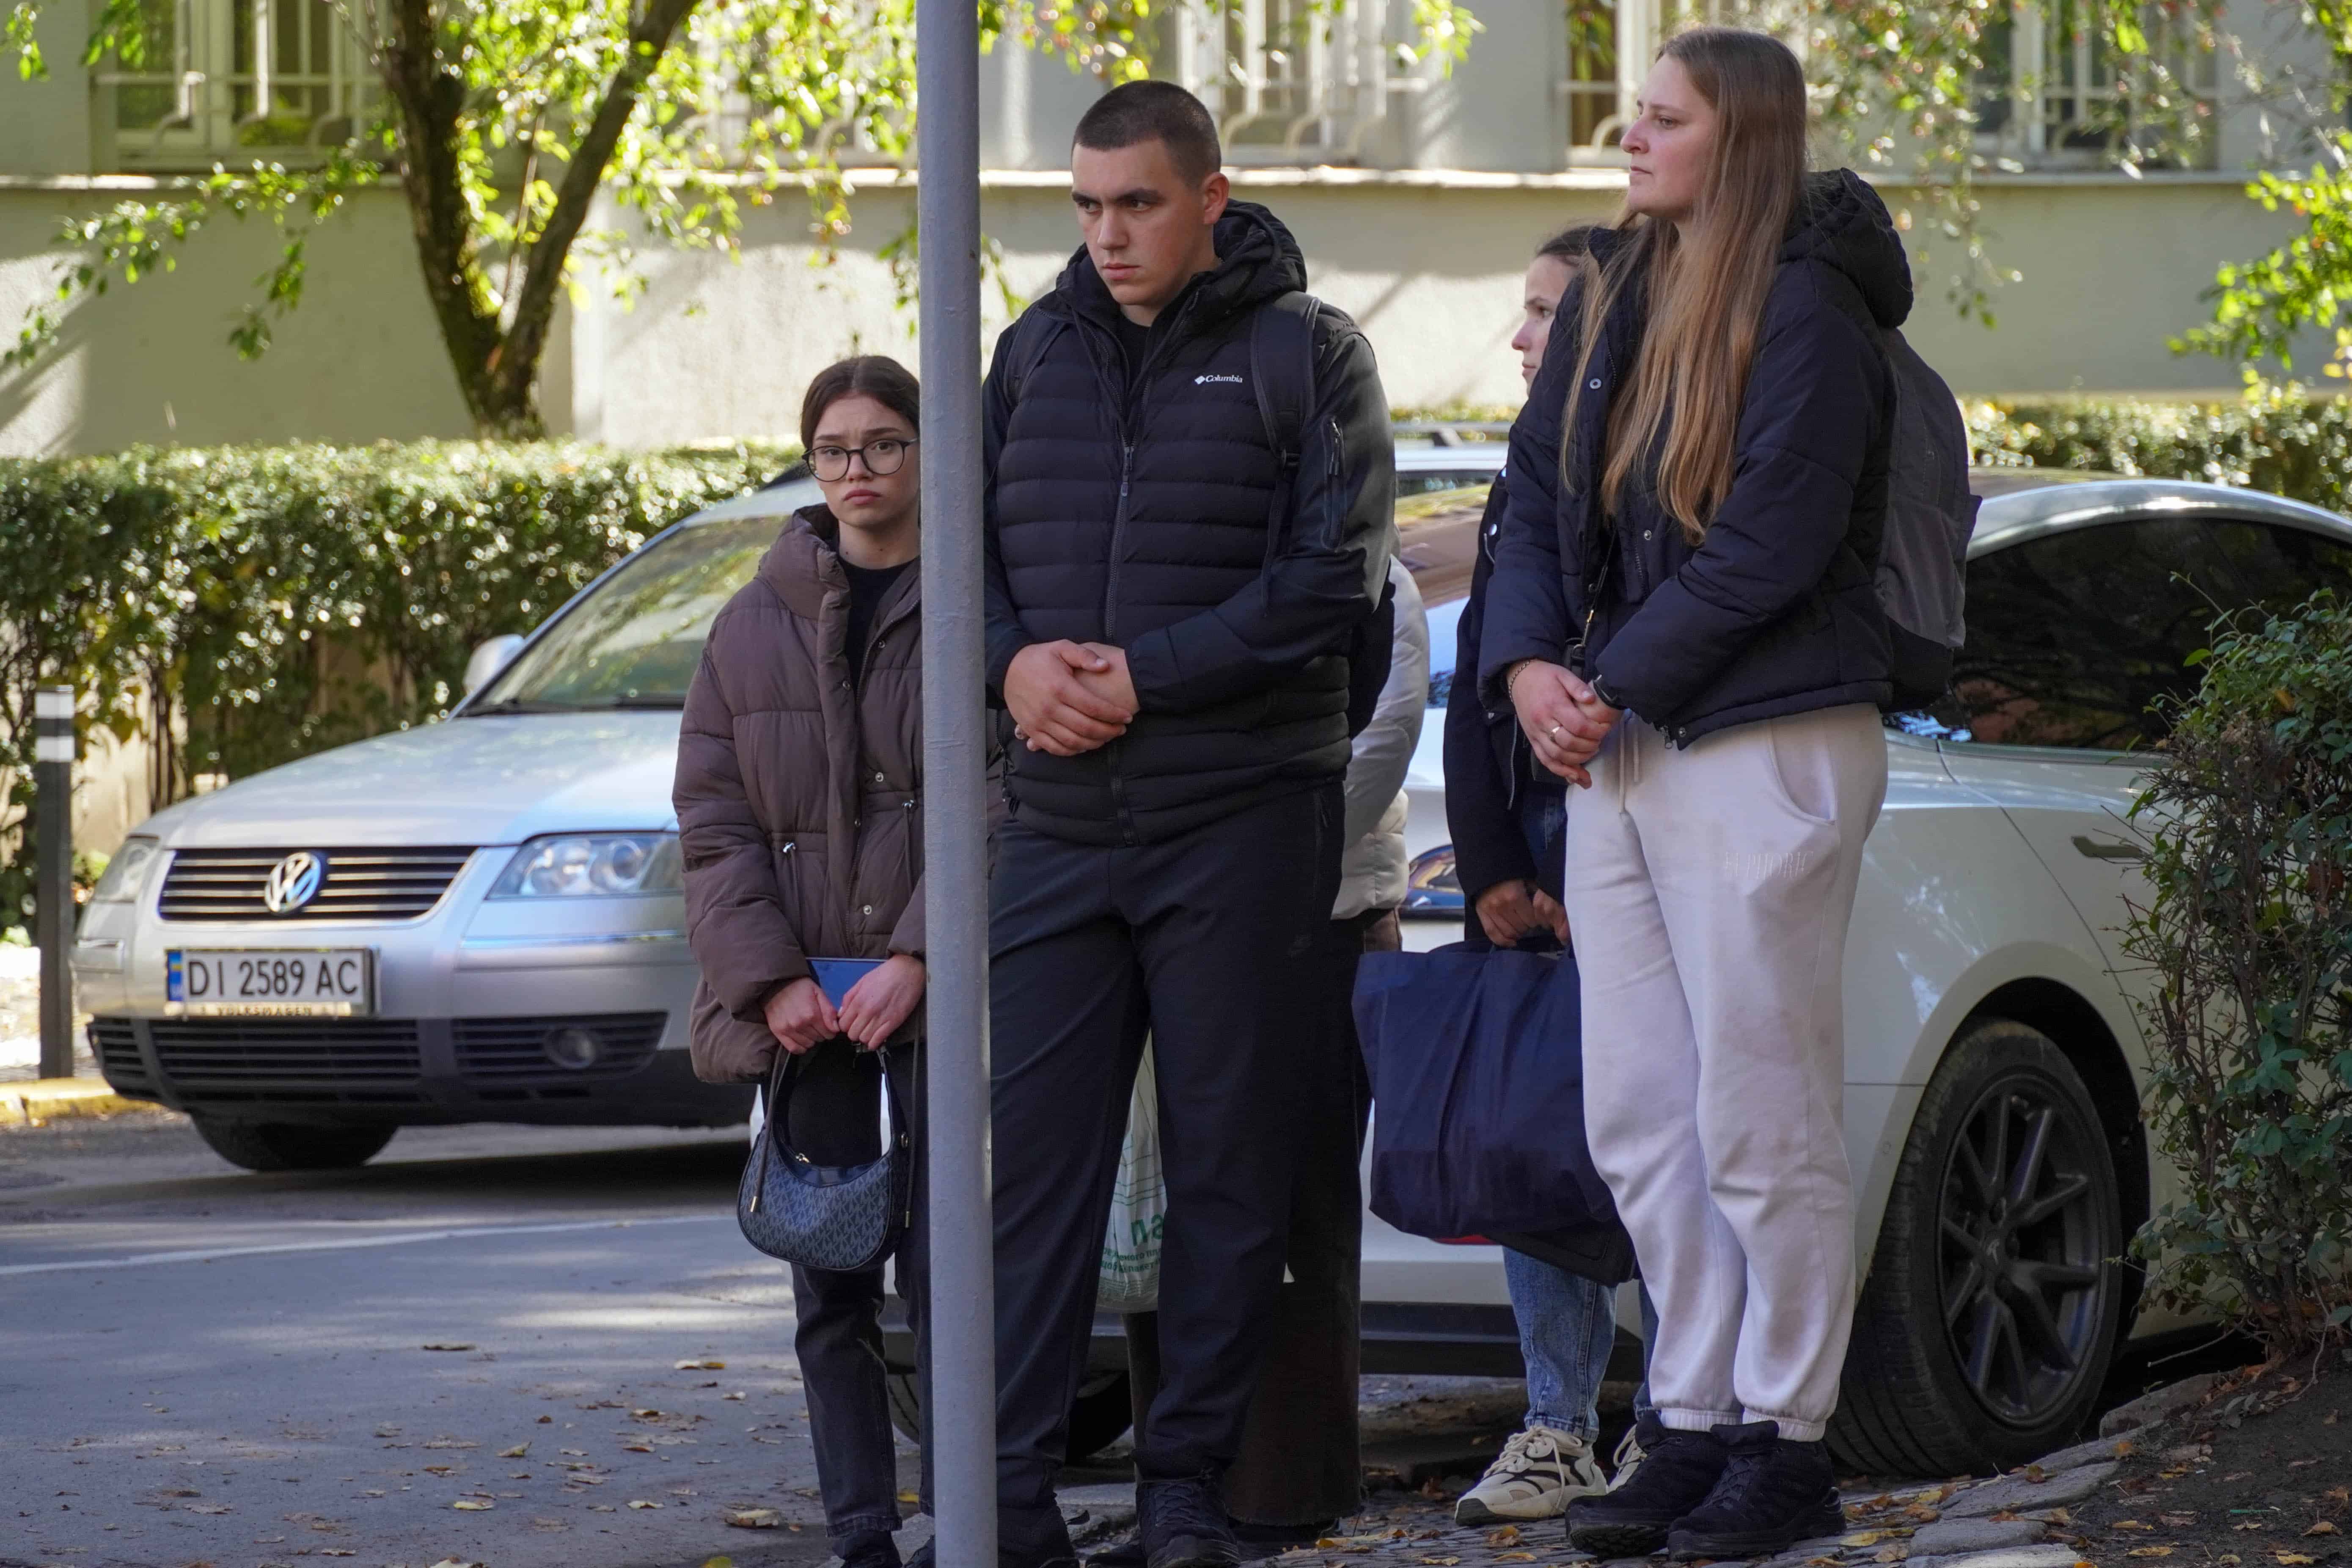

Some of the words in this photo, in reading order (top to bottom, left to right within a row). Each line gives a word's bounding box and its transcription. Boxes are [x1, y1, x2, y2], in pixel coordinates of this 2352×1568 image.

[1205, 374, 1243, 383] Columbia
[189, 959, 224, 996] DI
[239, 959, 305, 996] 2589
[316, 959, 358, 996] AC
